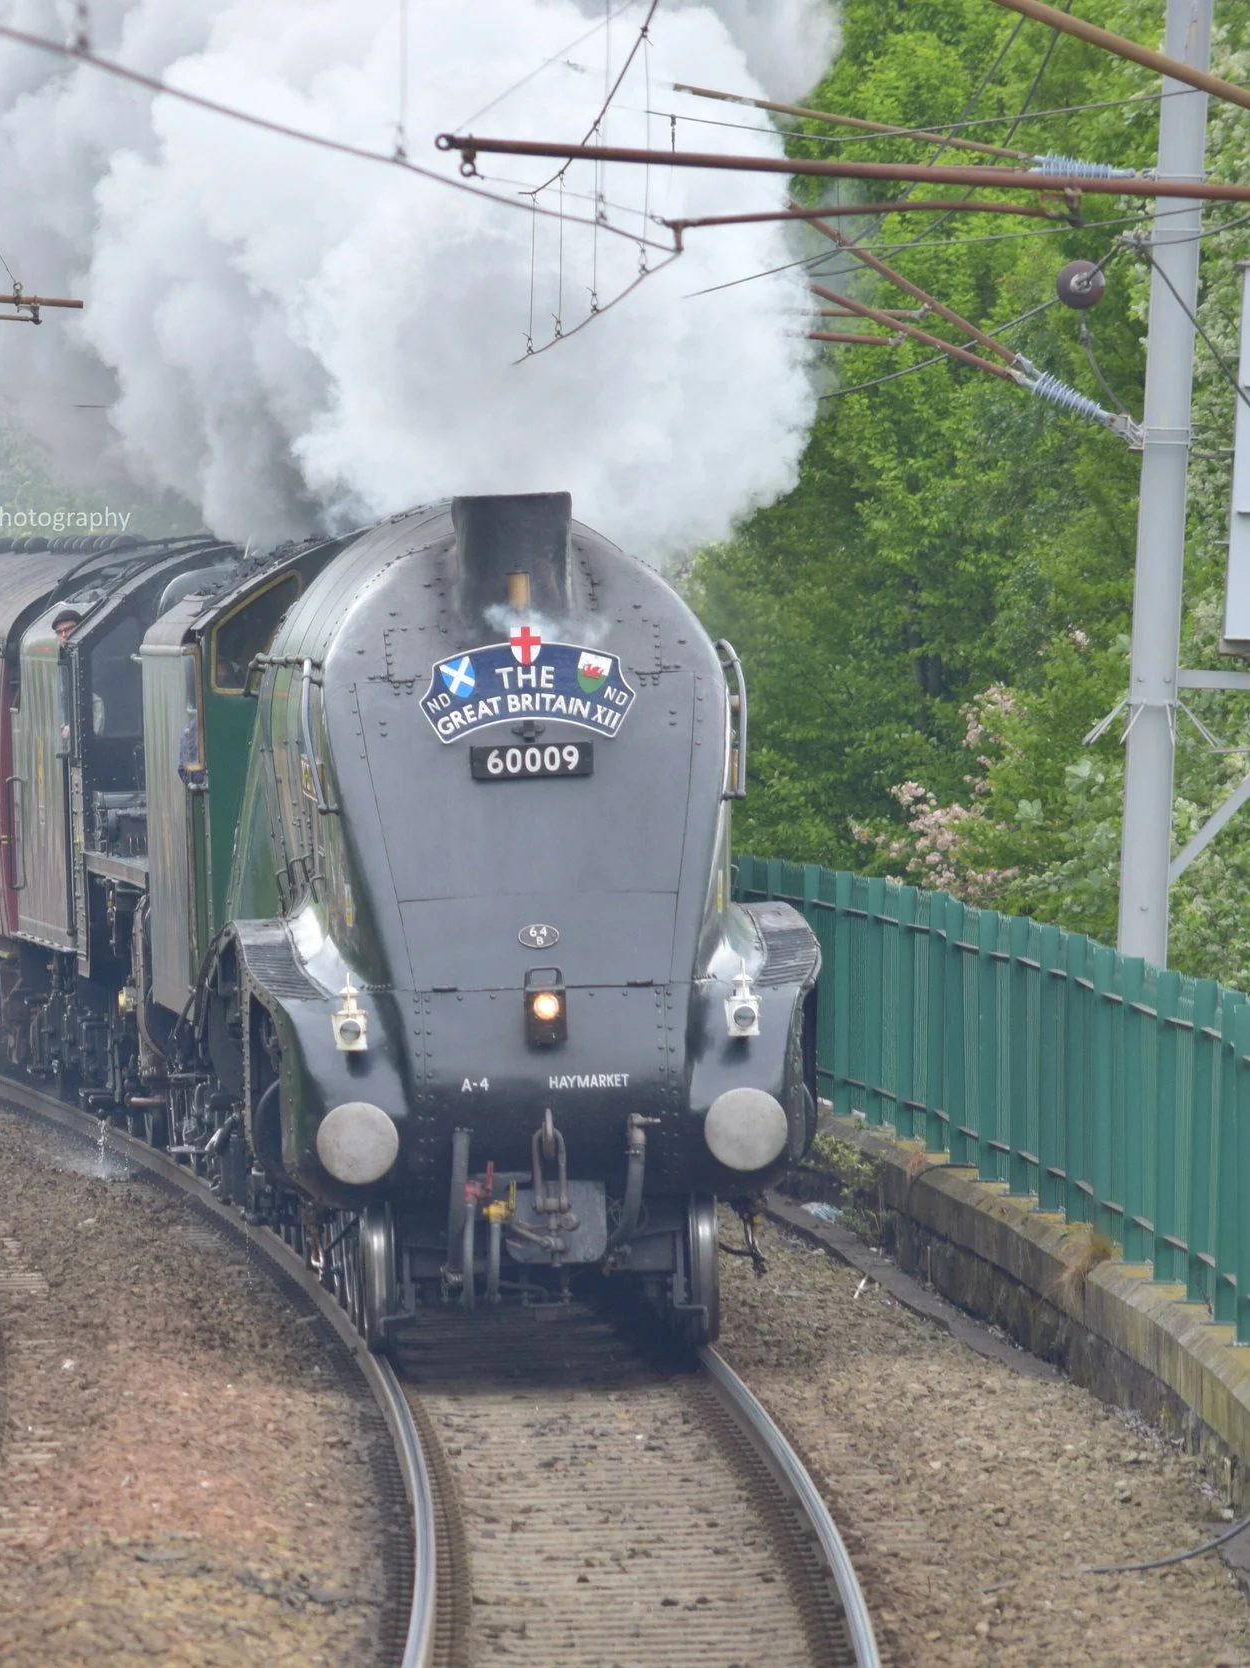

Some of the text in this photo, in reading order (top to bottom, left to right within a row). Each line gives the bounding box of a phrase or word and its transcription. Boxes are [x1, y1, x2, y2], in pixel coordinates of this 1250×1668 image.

[495, 666, 555, 689] THE
[427, 693, 451, 714] ND
[603, 685, 629, 706] ND
[437, 692, 622, 735] GREAT BRITAIN XII
[487, 745, 579, 775] 60009
[529, 926, 547, 937] 64
[461, 1077, 490, 1092] A-4
[549, 1073, 630, 1089] HAYMARKET
